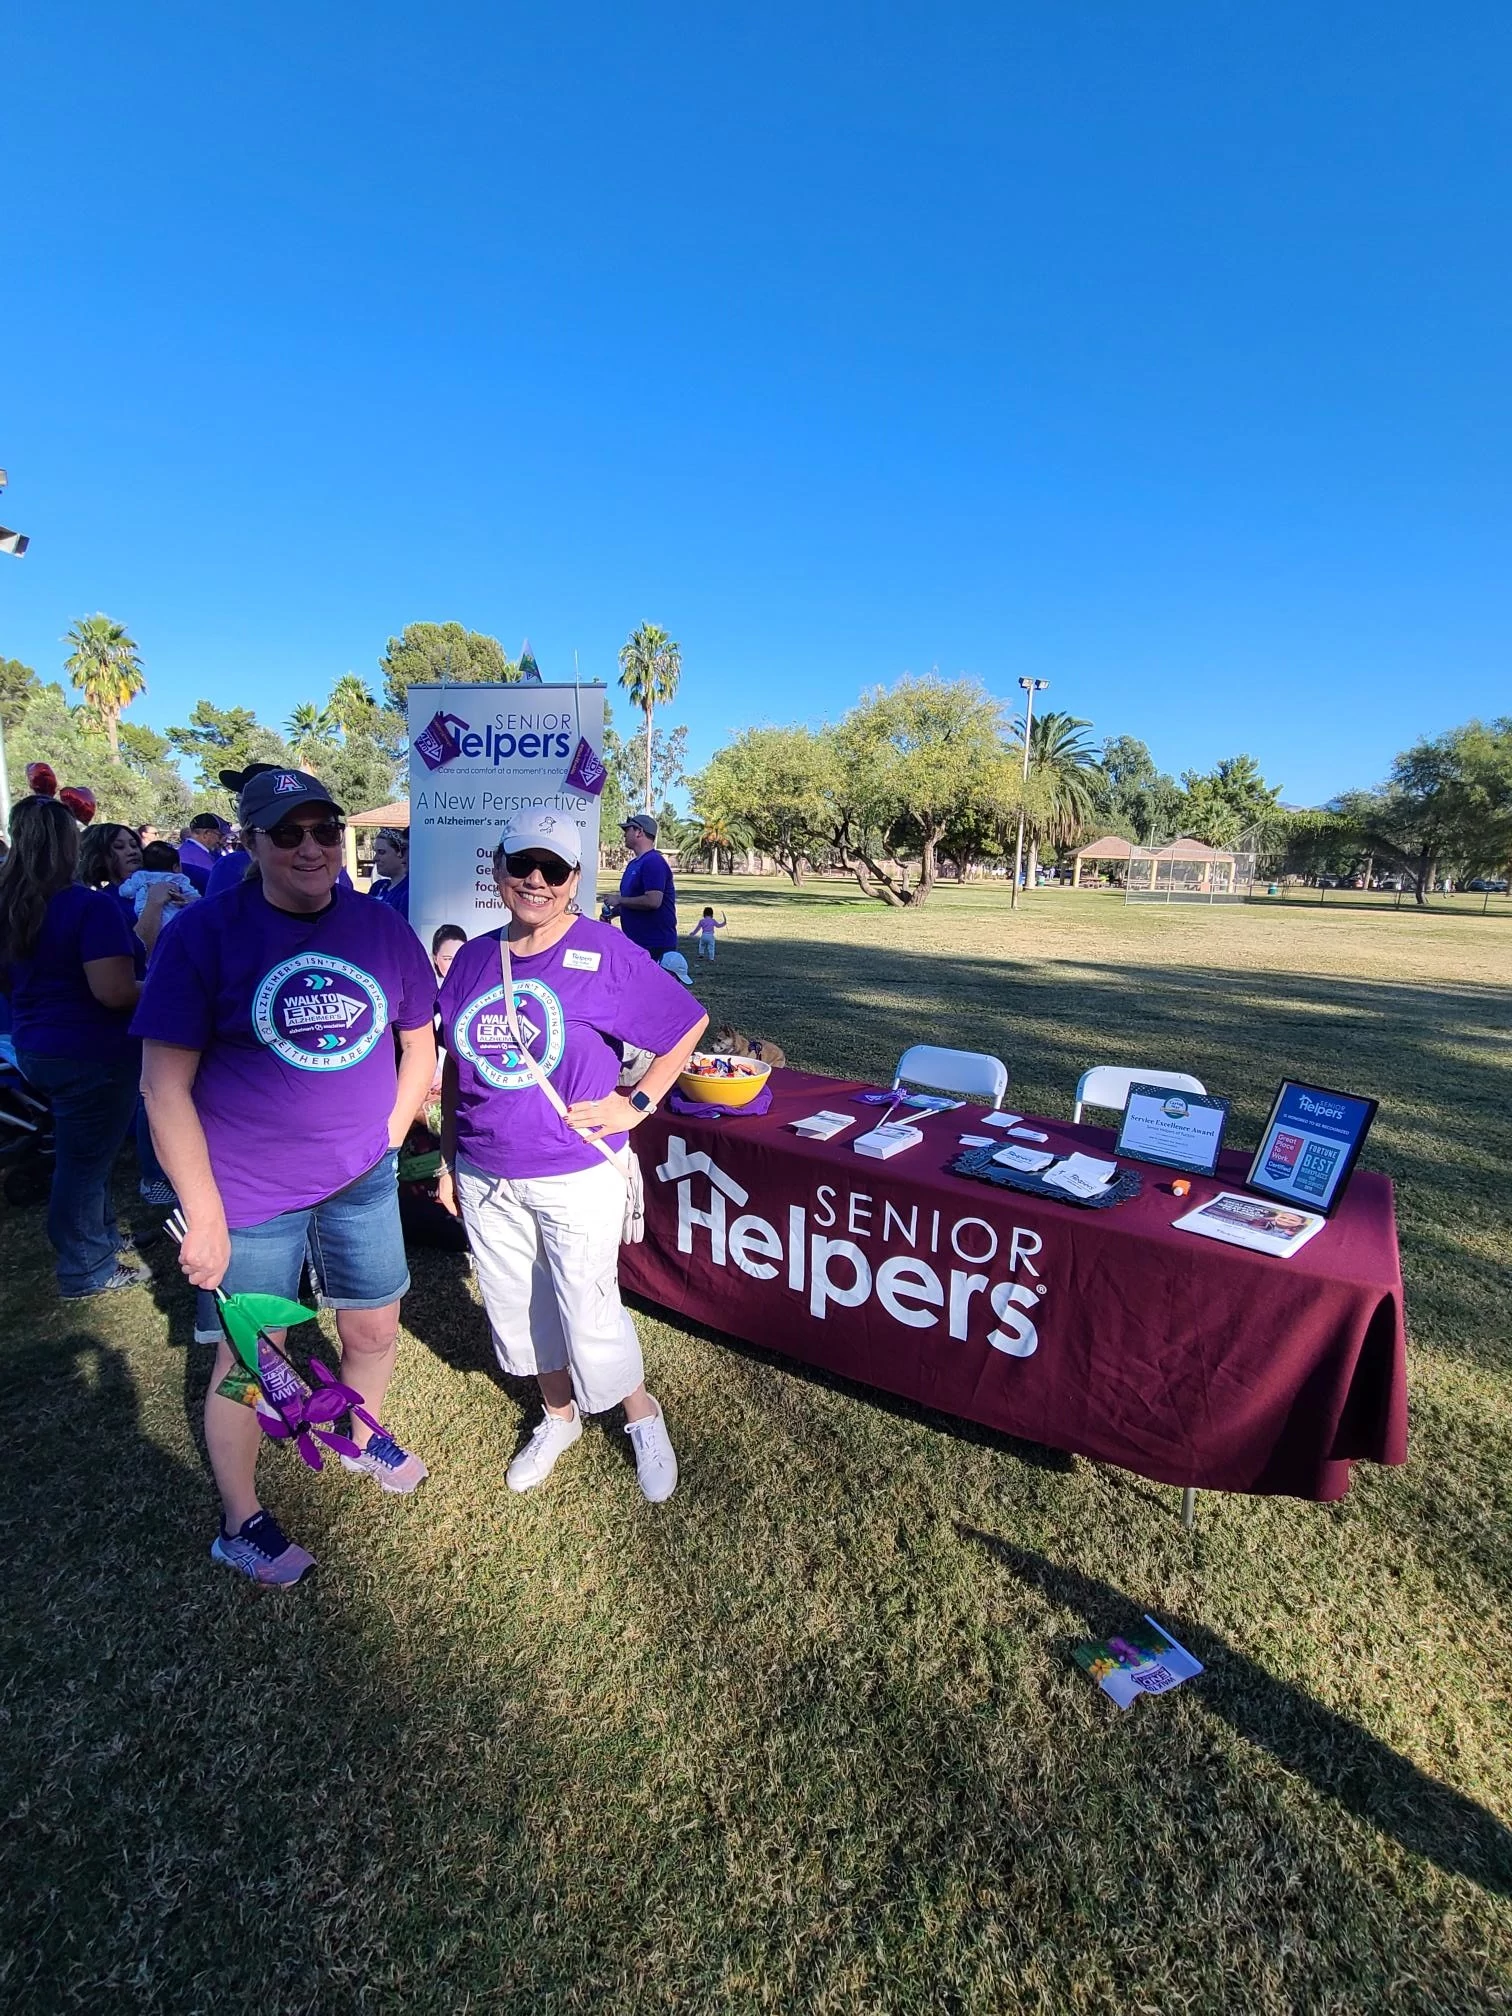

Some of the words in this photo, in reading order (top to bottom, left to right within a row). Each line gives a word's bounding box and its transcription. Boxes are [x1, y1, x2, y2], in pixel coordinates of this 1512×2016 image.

[494, 713, 571, 730] SENIOR
[438, 767, 455, 775] Care
[456, 767, 470, 775] and
[471, 767, 498, 775] comfort
[498, 767, 505, 775] at
[512, 768, 547, 776] moment's
[274, 774, 307, 794] A
[416, 792, 429, 810] A
[434, 792, 476, 810] New
[482, 792, 587, 813] Perspective
[424, 818, 435, 826] on
[437, 816, 492, 827] Alzheimer's
[476, 847, 494, 858] Ou
[258, 960, 302, 1022] ALZHEIMER'S
[306, 956, 337, 969] ISN'T
[342, 965, 384, 1009] STOPPING
[284, 994, 321, 1008] WALK
[320, 993, 336, 1004] TO
[287, 1004, 340, 1020] END
[481, 1014, 508, 1025] WAL
[288, 1014, 342, 1026] ALZHEIMER'S
[479, 1025, 509, 1036] EN
[270, 1037, 331, 1066] NEITHER
[340, 1047, 363, 1064] ARE
[364, 1027, 381, 1044] WE
[517, 1073, 534, 1083] AR
[543, 1054, 557, 1070] WE
[1299, 1099, 1344, 1120] Helpers
[1319, 1100, 1347, 1111] SENIOR
[1130, 1114, 1155, 1125] Service
[1155, 1119, 1191, 1132] Excellence
[1191, 1127, 1215, 1137] Award
[1275, 1141, 1295, 1151] Place
[1278, 1133, 1297, 1145] Great
[1274, 1145, 1282, 1153] To
[1309, 1144, 1338, 1159] FORTUNE
[1268, 1160, 1292, 1173] Certified
[1303, 1154, 1334, 1174] BEST
[813, 1184, 1043, 1278] SENIOR
